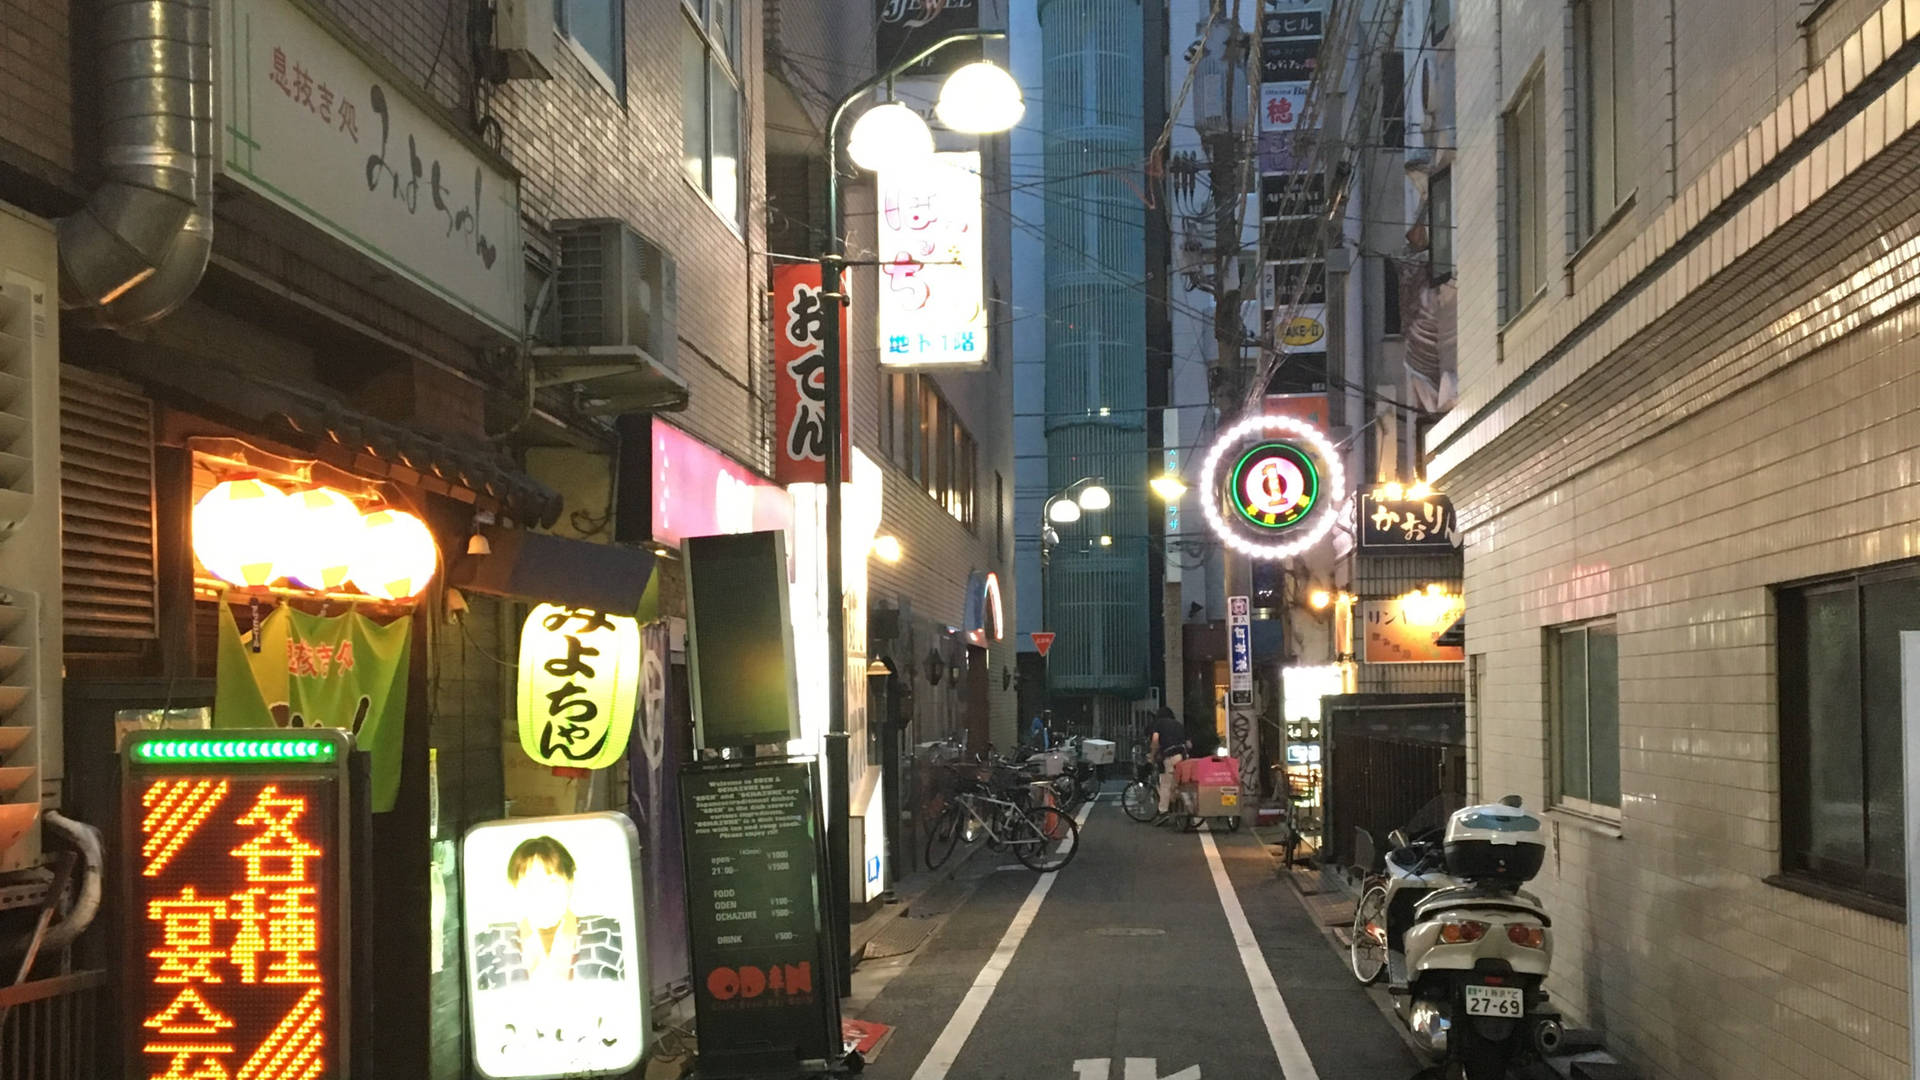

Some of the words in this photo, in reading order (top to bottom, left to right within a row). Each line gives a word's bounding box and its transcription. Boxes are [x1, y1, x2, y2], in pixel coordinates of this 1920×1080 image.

[269, 46, 359, 144] 息抜き処
[366, 83, 487, 255] みよちゃん
[540, 606, 615, 760] みよちゃん
[230, 786, 321, 983] 各種
[713, 889, 735, 898] FOOD
[714, 901, 737, 910] ODEN
[715, 911, 757, 921] OCHAZUKE
[717, 936, 742, 944] DRINK
[143, 886, 235, 1080] 宴会
[1470, 997, 1520, 1015] 27-69
